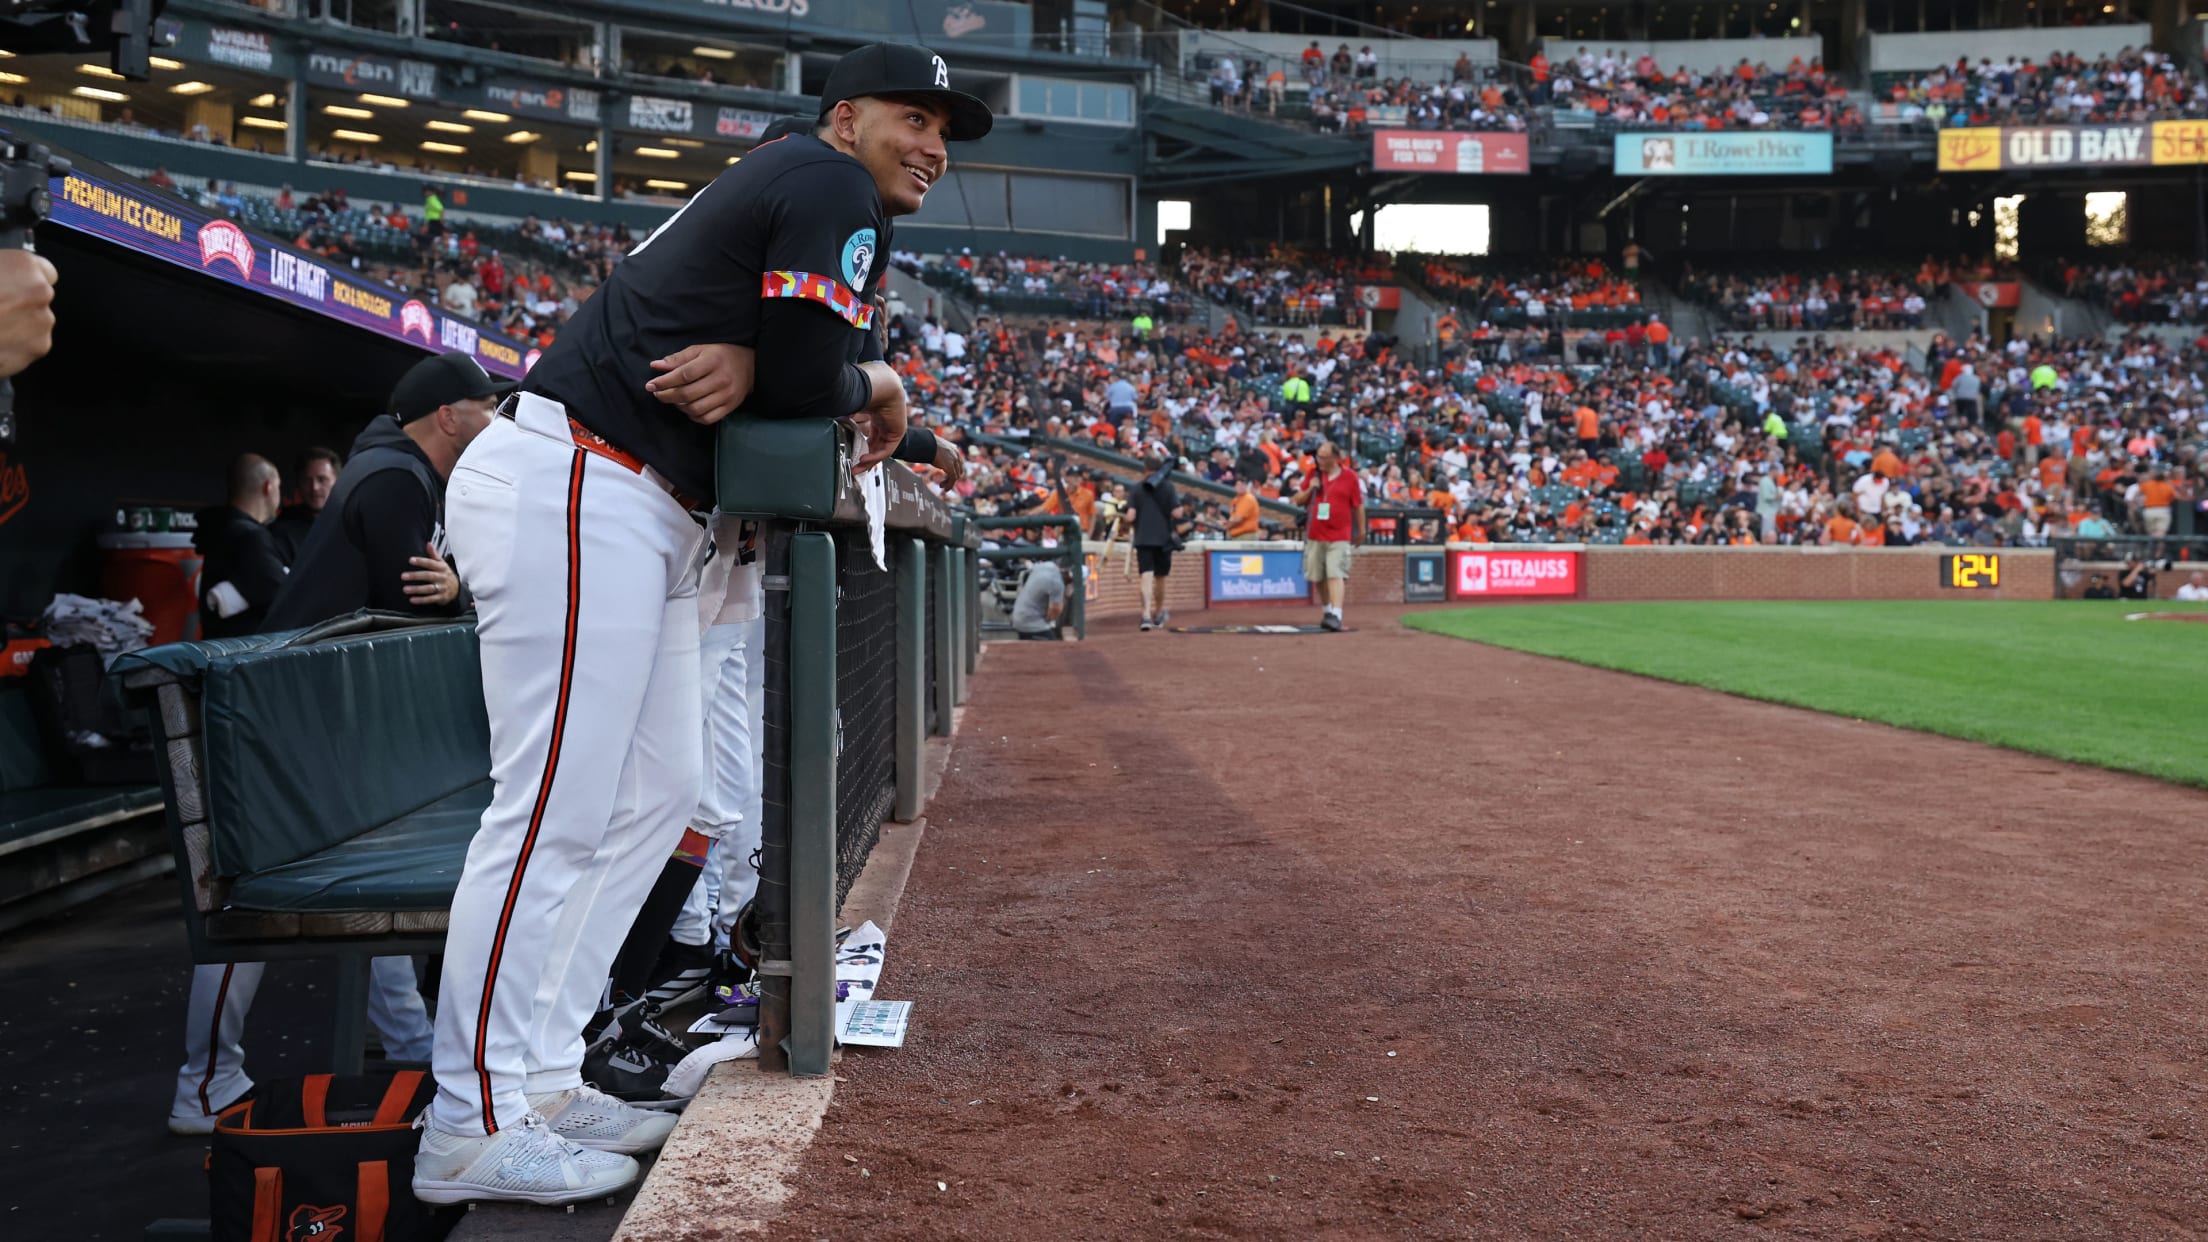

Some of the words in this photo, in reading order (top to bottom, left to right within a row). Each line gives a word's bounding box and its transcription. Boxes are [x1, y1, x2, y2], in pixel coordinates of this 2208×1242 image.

[1387, 137, 1410, 150] THIS
[2009, 130, 2073, 165] OLD
[1393, 151, 1414, 163] FOR
[1416, 151, 1437, 163] YOU
[63, 176, 121, 220] PREMIUM
[123, 198, 141, 228] ICE
[143, 206, 182, 242] CREAM
[270, 248, 296, 291] LATE
[296, 258, 328, 302] NIGHT
[1490, 559, 1568, 578] STRAUSS
[1953, 554, 1998, 588] 124
[1221, 578, 1262, 596] MedStar
[1263, 577, 1296, 595] Health
